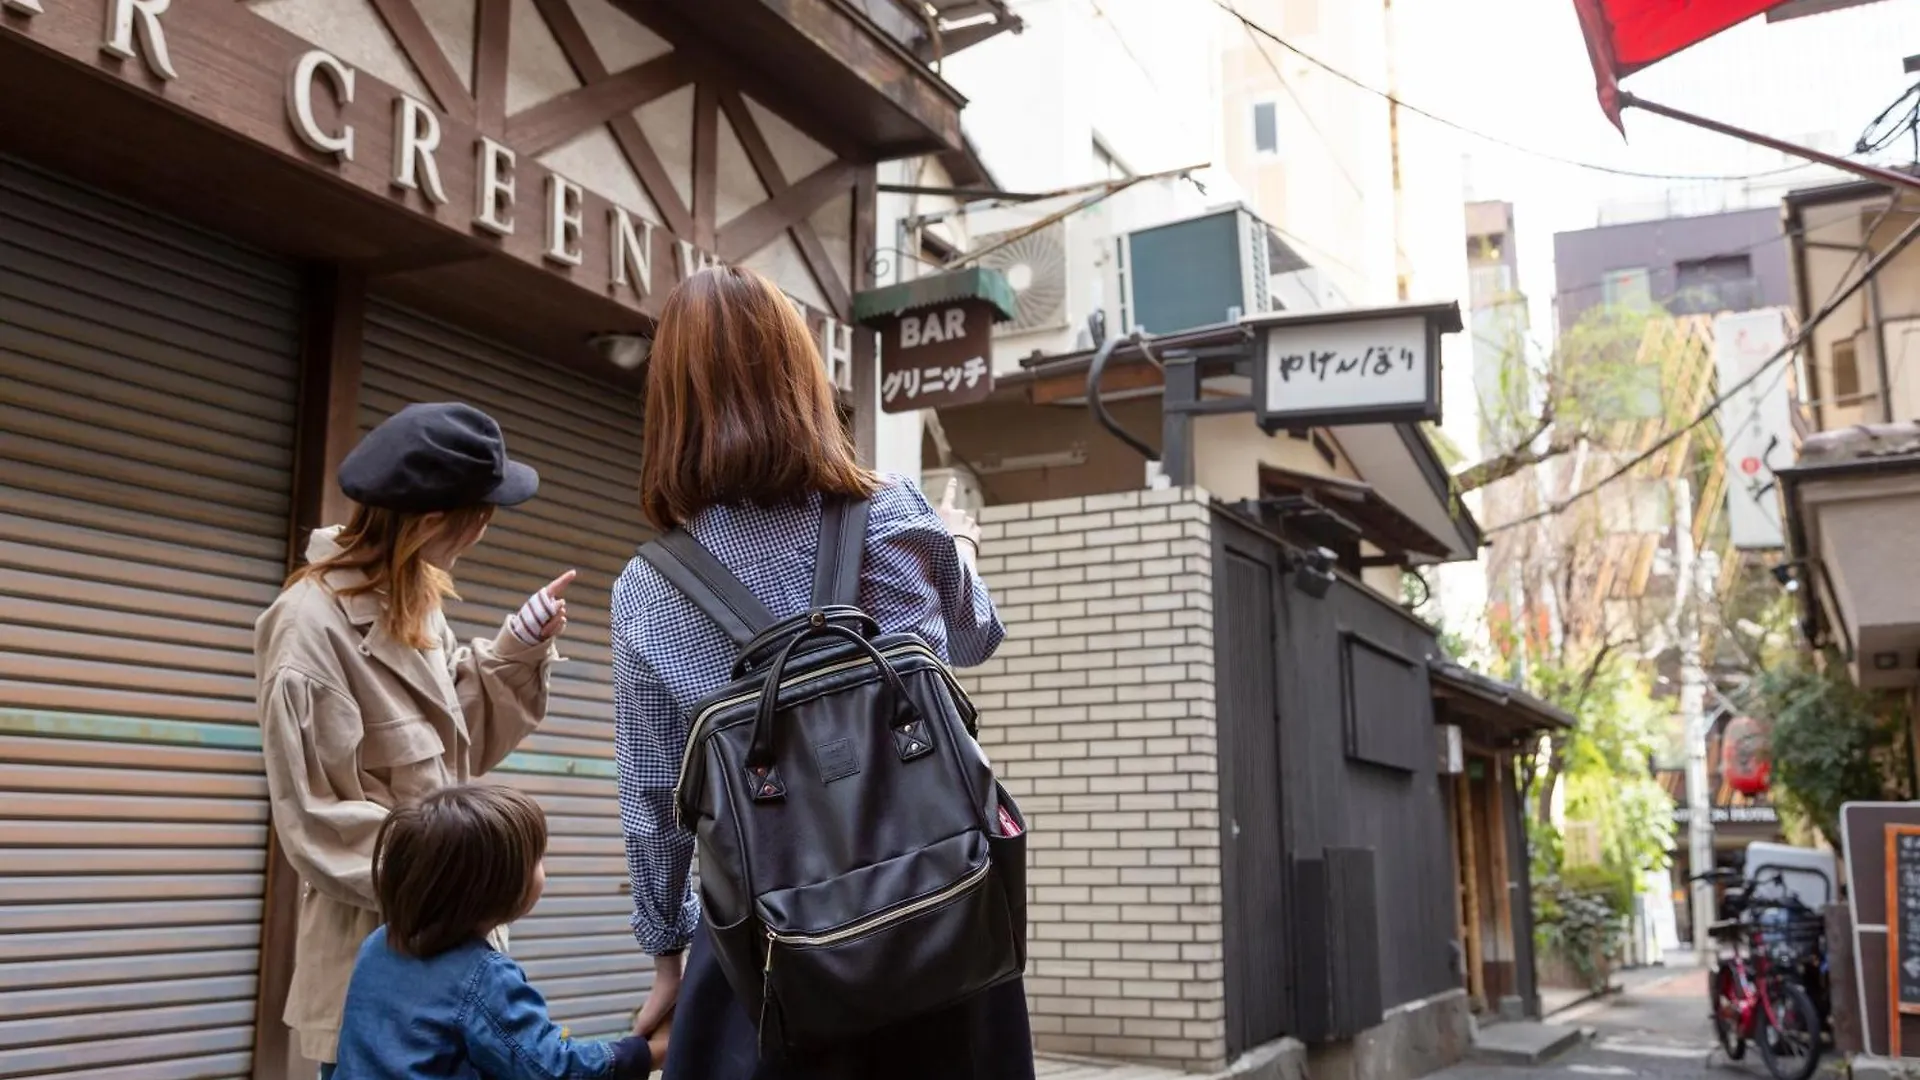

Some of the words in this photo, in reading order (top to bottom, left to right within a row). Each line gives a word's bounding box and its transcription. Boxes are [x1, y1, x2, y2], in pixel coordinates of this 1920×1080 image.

[901, 308, 966, 349] BAR
[882, 356, 987, 402] グリニッチ
